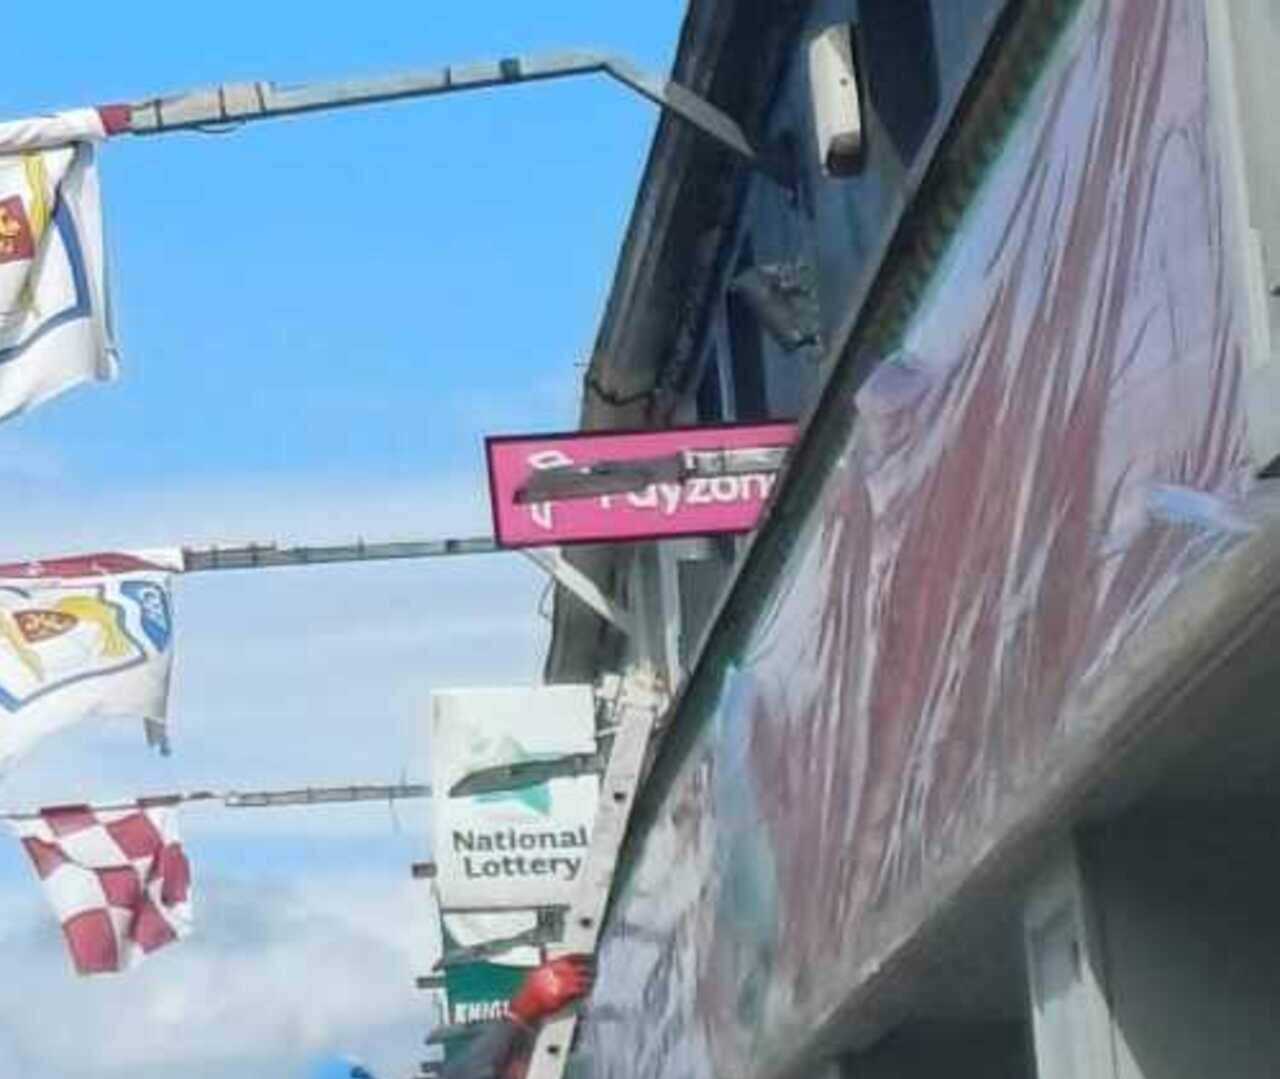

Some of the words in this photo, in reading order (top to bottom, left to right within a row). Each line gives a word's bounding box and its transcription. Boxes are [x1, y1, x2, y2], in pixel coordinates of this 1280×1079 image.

[600, 473, 776, 516] ayzon
[452, 823, 590, 852] National
[463, 855, 582, 881] Lottery
